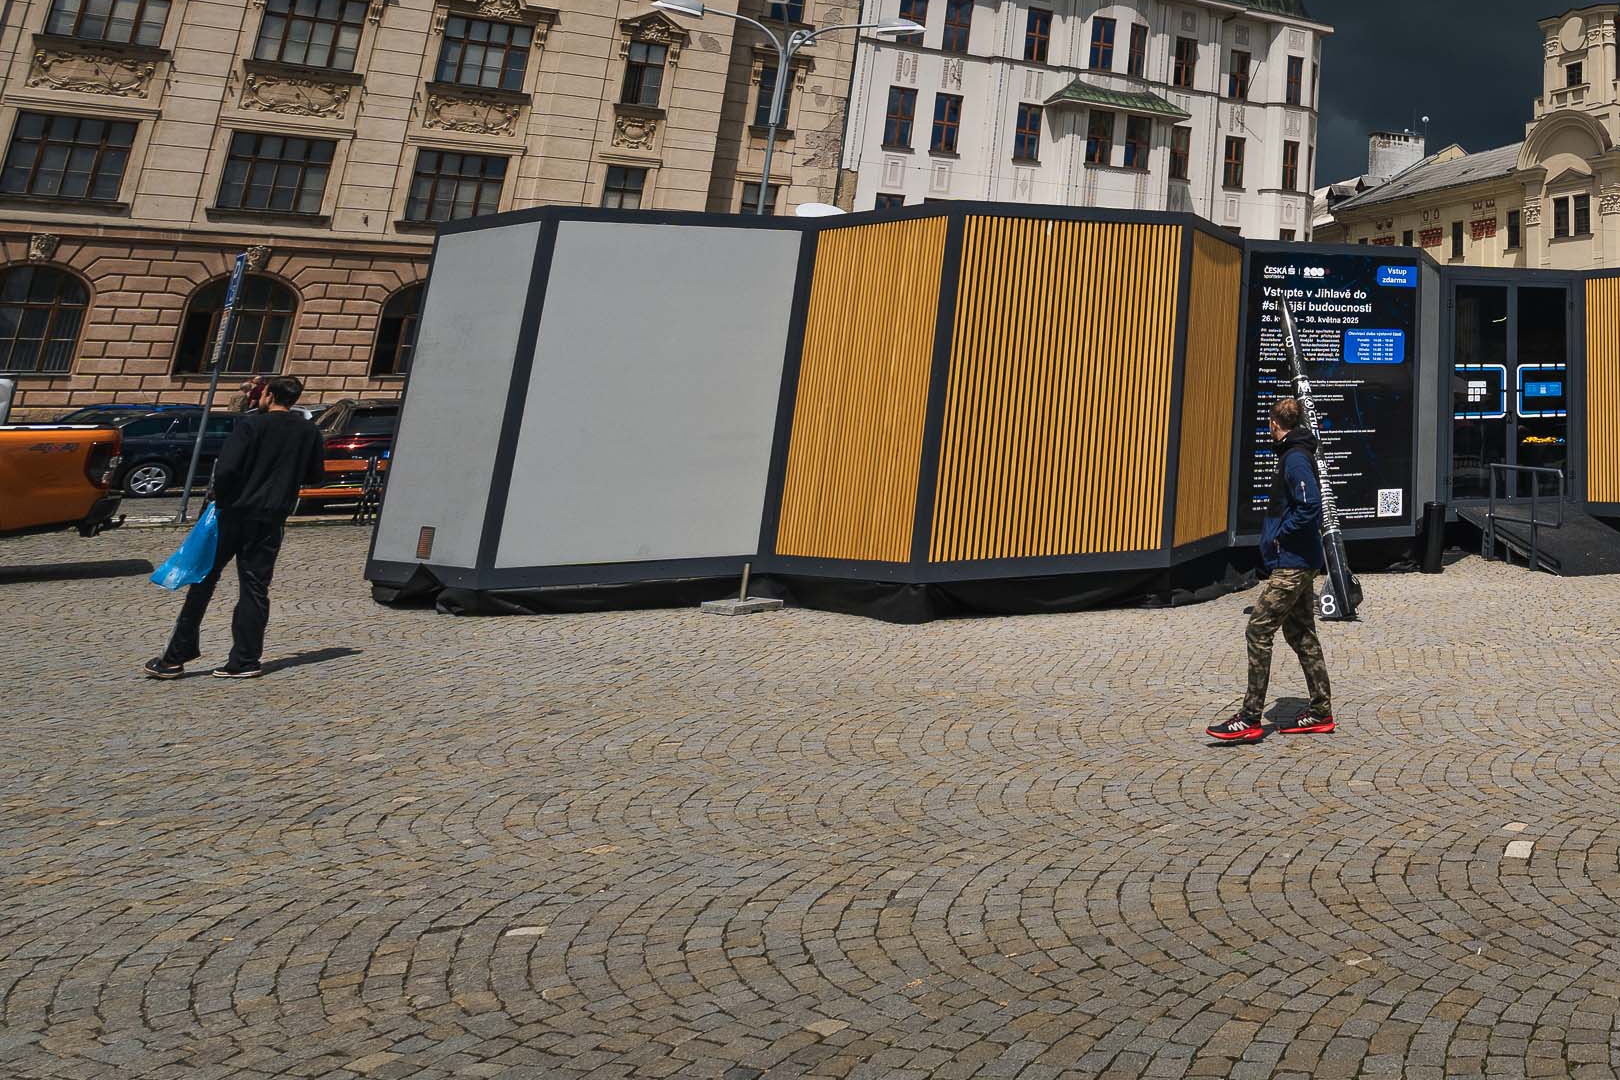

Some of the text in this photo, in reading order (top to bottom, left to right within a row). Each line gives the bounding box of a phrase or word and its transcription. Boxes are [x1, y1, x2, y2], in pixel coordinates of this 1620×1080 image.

[1263, 265, 1288, 275] ČESKÁ
[1388, 267, 1407, 276] Vstup
[1306, 290, 1313, 298] v
[1314, 288, 1351, 299] Jihlavě
[1353, 290, 1367, 299] do
[1308, 302, 1372, 313] budoucnosti
[1342, 316, 1359, 324] 2025
[1320, 594, 1336, 615] 8
